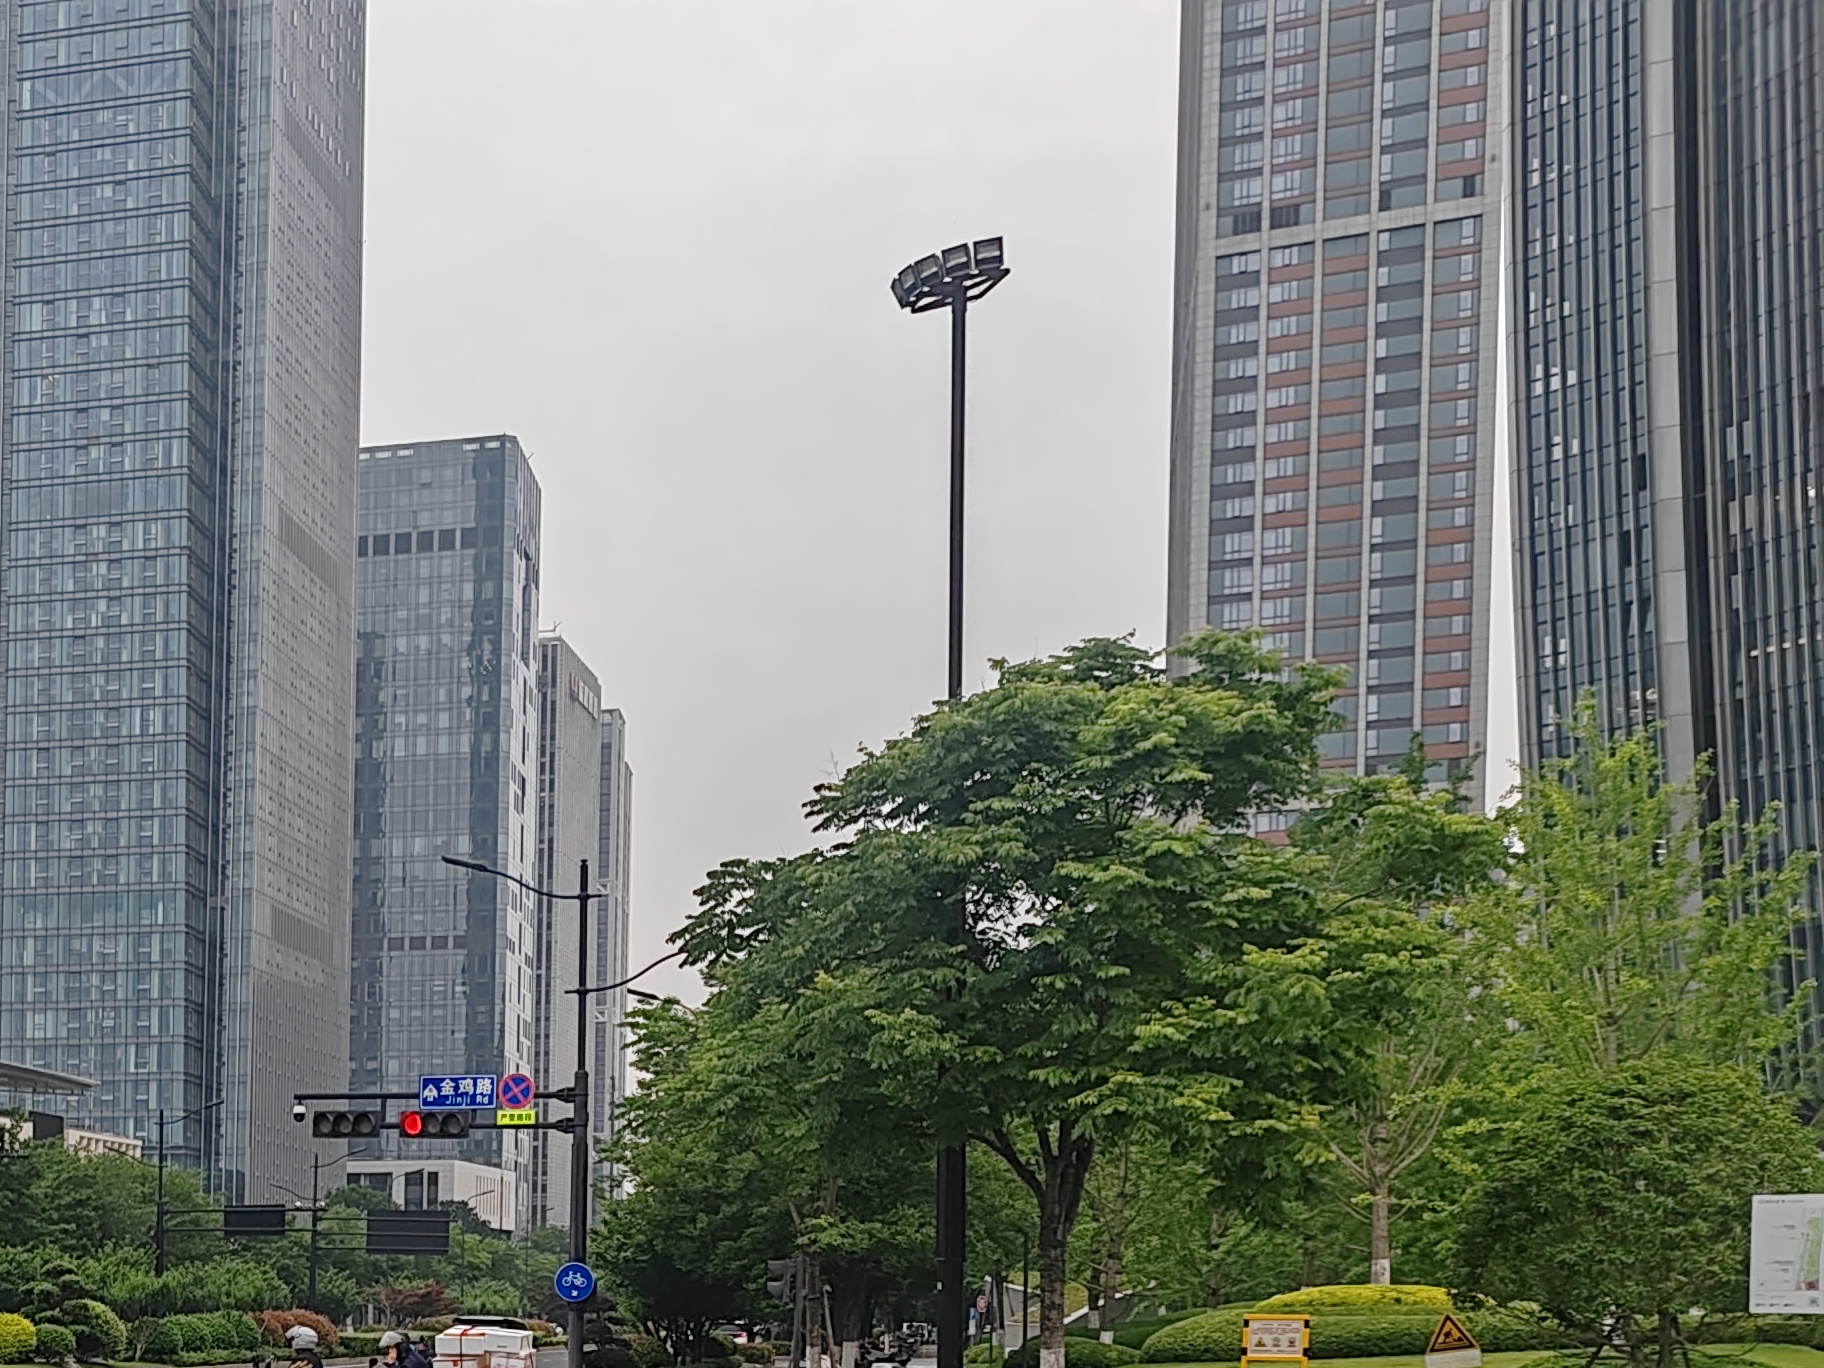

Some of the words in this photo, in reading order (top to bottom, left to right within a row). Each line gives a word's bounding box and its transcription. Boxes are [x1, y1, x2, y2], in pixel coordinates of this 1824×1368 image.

[439, 1078, 492, 1095] 金鸡路
[445, 1094, 471, 1107] Jinji
[476, 1094, 489, 1104] Rd
